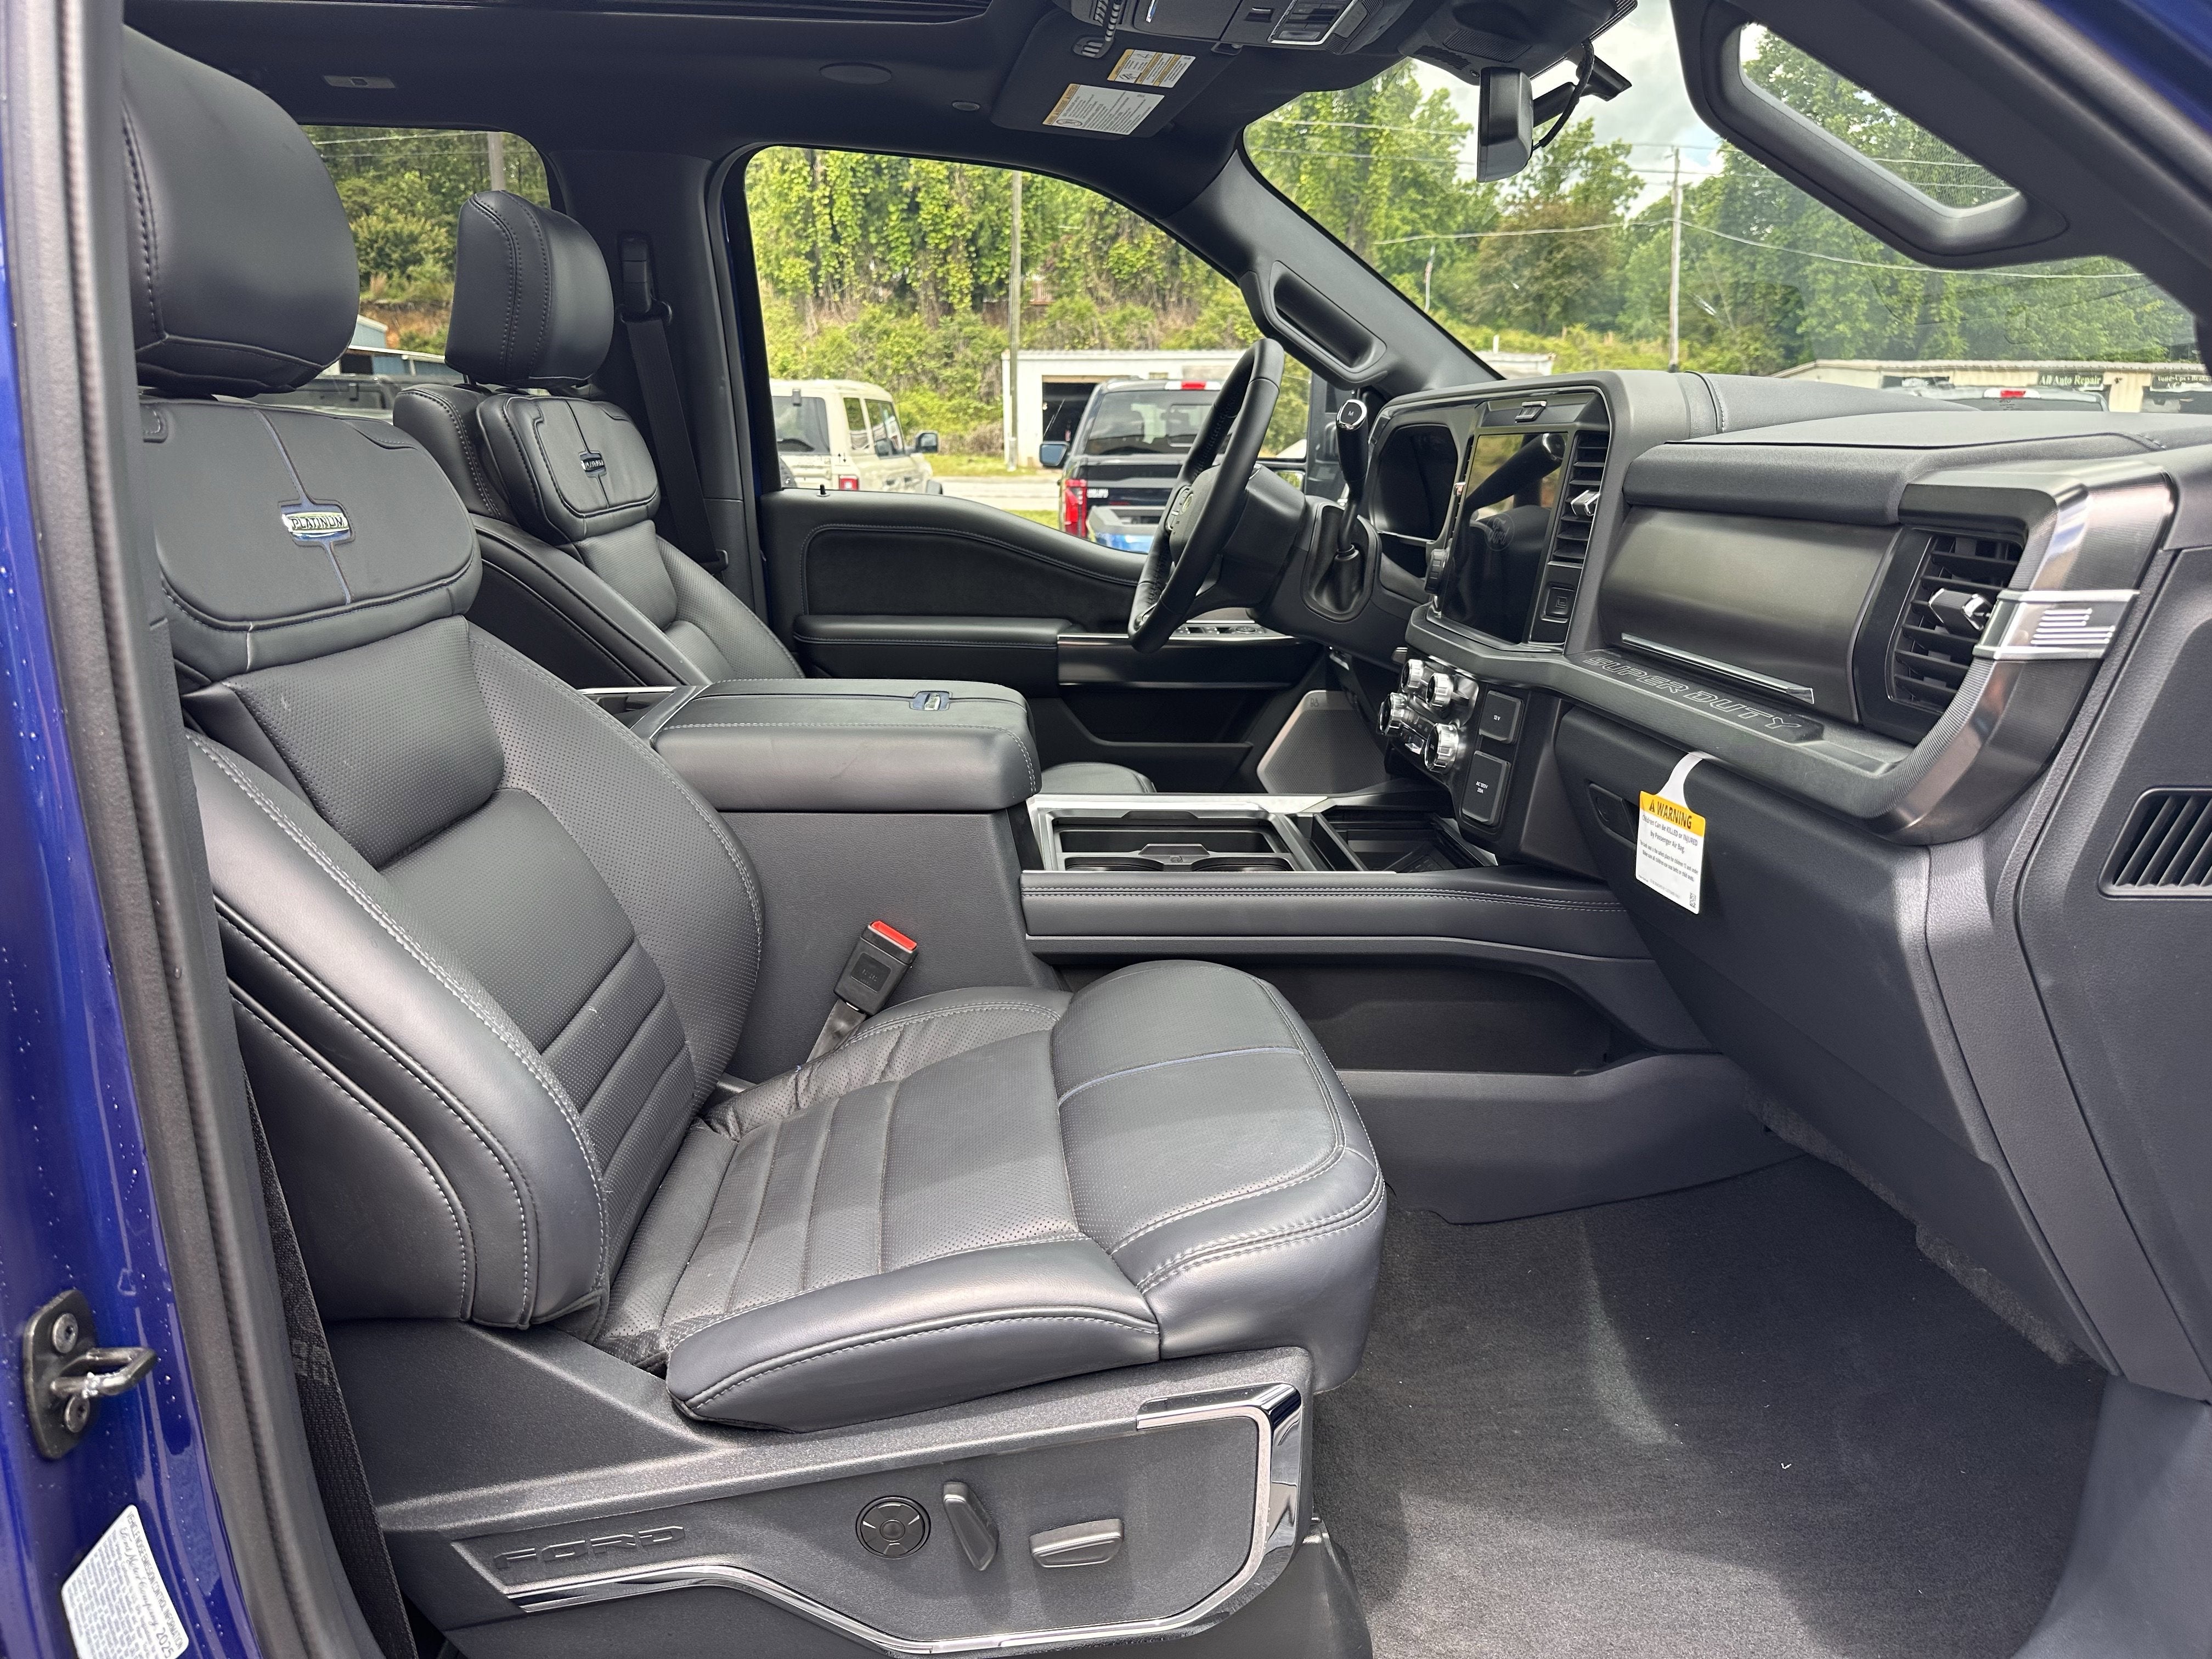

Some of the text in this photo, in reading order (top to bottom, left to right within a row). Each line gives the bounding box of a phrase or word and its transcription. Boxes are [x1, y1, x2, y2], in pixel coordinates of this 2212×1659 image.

[2040, 374, 2101, 385] All Auto Repair
[291, 516, 344, 529] PLATINUM
[1488, 517, 1510, 545] Ford
[1582, 657, 1802, 729] SUPER DUTY
[1657, 801, 1692, 830] WARNING
[1655, 832, 1672, 846] Passenger
[1666, 826, 1678, 837] KILLED
[1683, 833, 1698, 846] INJURED
[127, 1511, 140, 1539] VEHICLE
[135, 1536, 146, 1558] NOISE
[141, 1553, 156, 1585] EMISSION
[151, 1581, 167, 1612] CONTROL
[494, 1525, 685, 1570] FORD
[156, 1627, 174, 1658] 2025
